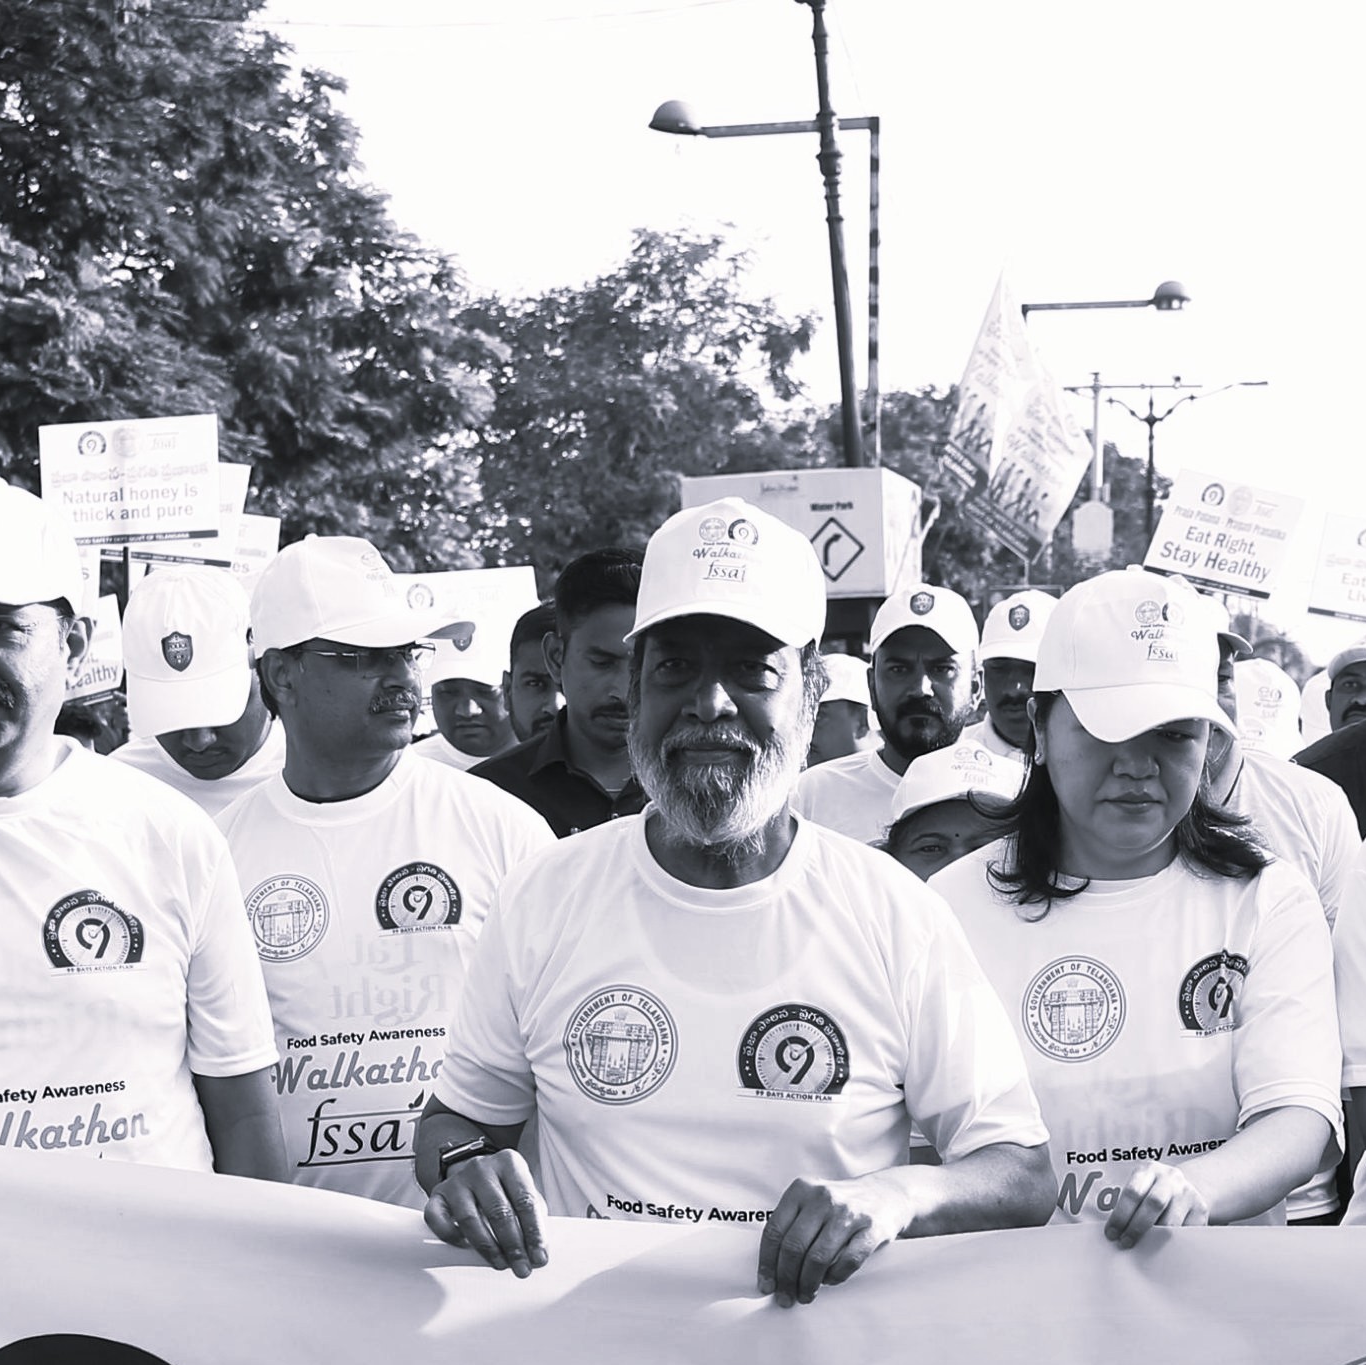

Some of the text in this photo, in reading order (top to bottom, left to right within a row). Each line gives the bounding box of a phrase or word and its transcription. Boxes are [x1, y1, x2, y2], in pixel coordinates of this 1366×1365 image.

[62, 484, 199, 506] Natural honey is
[73, 502, 194, 523] thick and pure
[1185, 526, 1257, 557] Eat Right,
[1160, 541, 1201, 569] Stay
[1206, 551, 1271, 584] Healthy
[1029, 963, 1119, 1011] GOVERNMENT OF TELANGANA
[571, 993, 670, 1047] GOVERNMENT OF TELANGANA
[287, 1026, 446, 1050] Food Safety Awareness
[271, 1045, 443, 1095] Walkatho
[42, 1079, 126, 1099] Awareness
[1066, 1149, 1108, 1165] Food
[1112, 1146, 1164, 1163] Safety
[606, 1194, 643, 1215] Food
[646, 1203, 703, 1223] Safety
